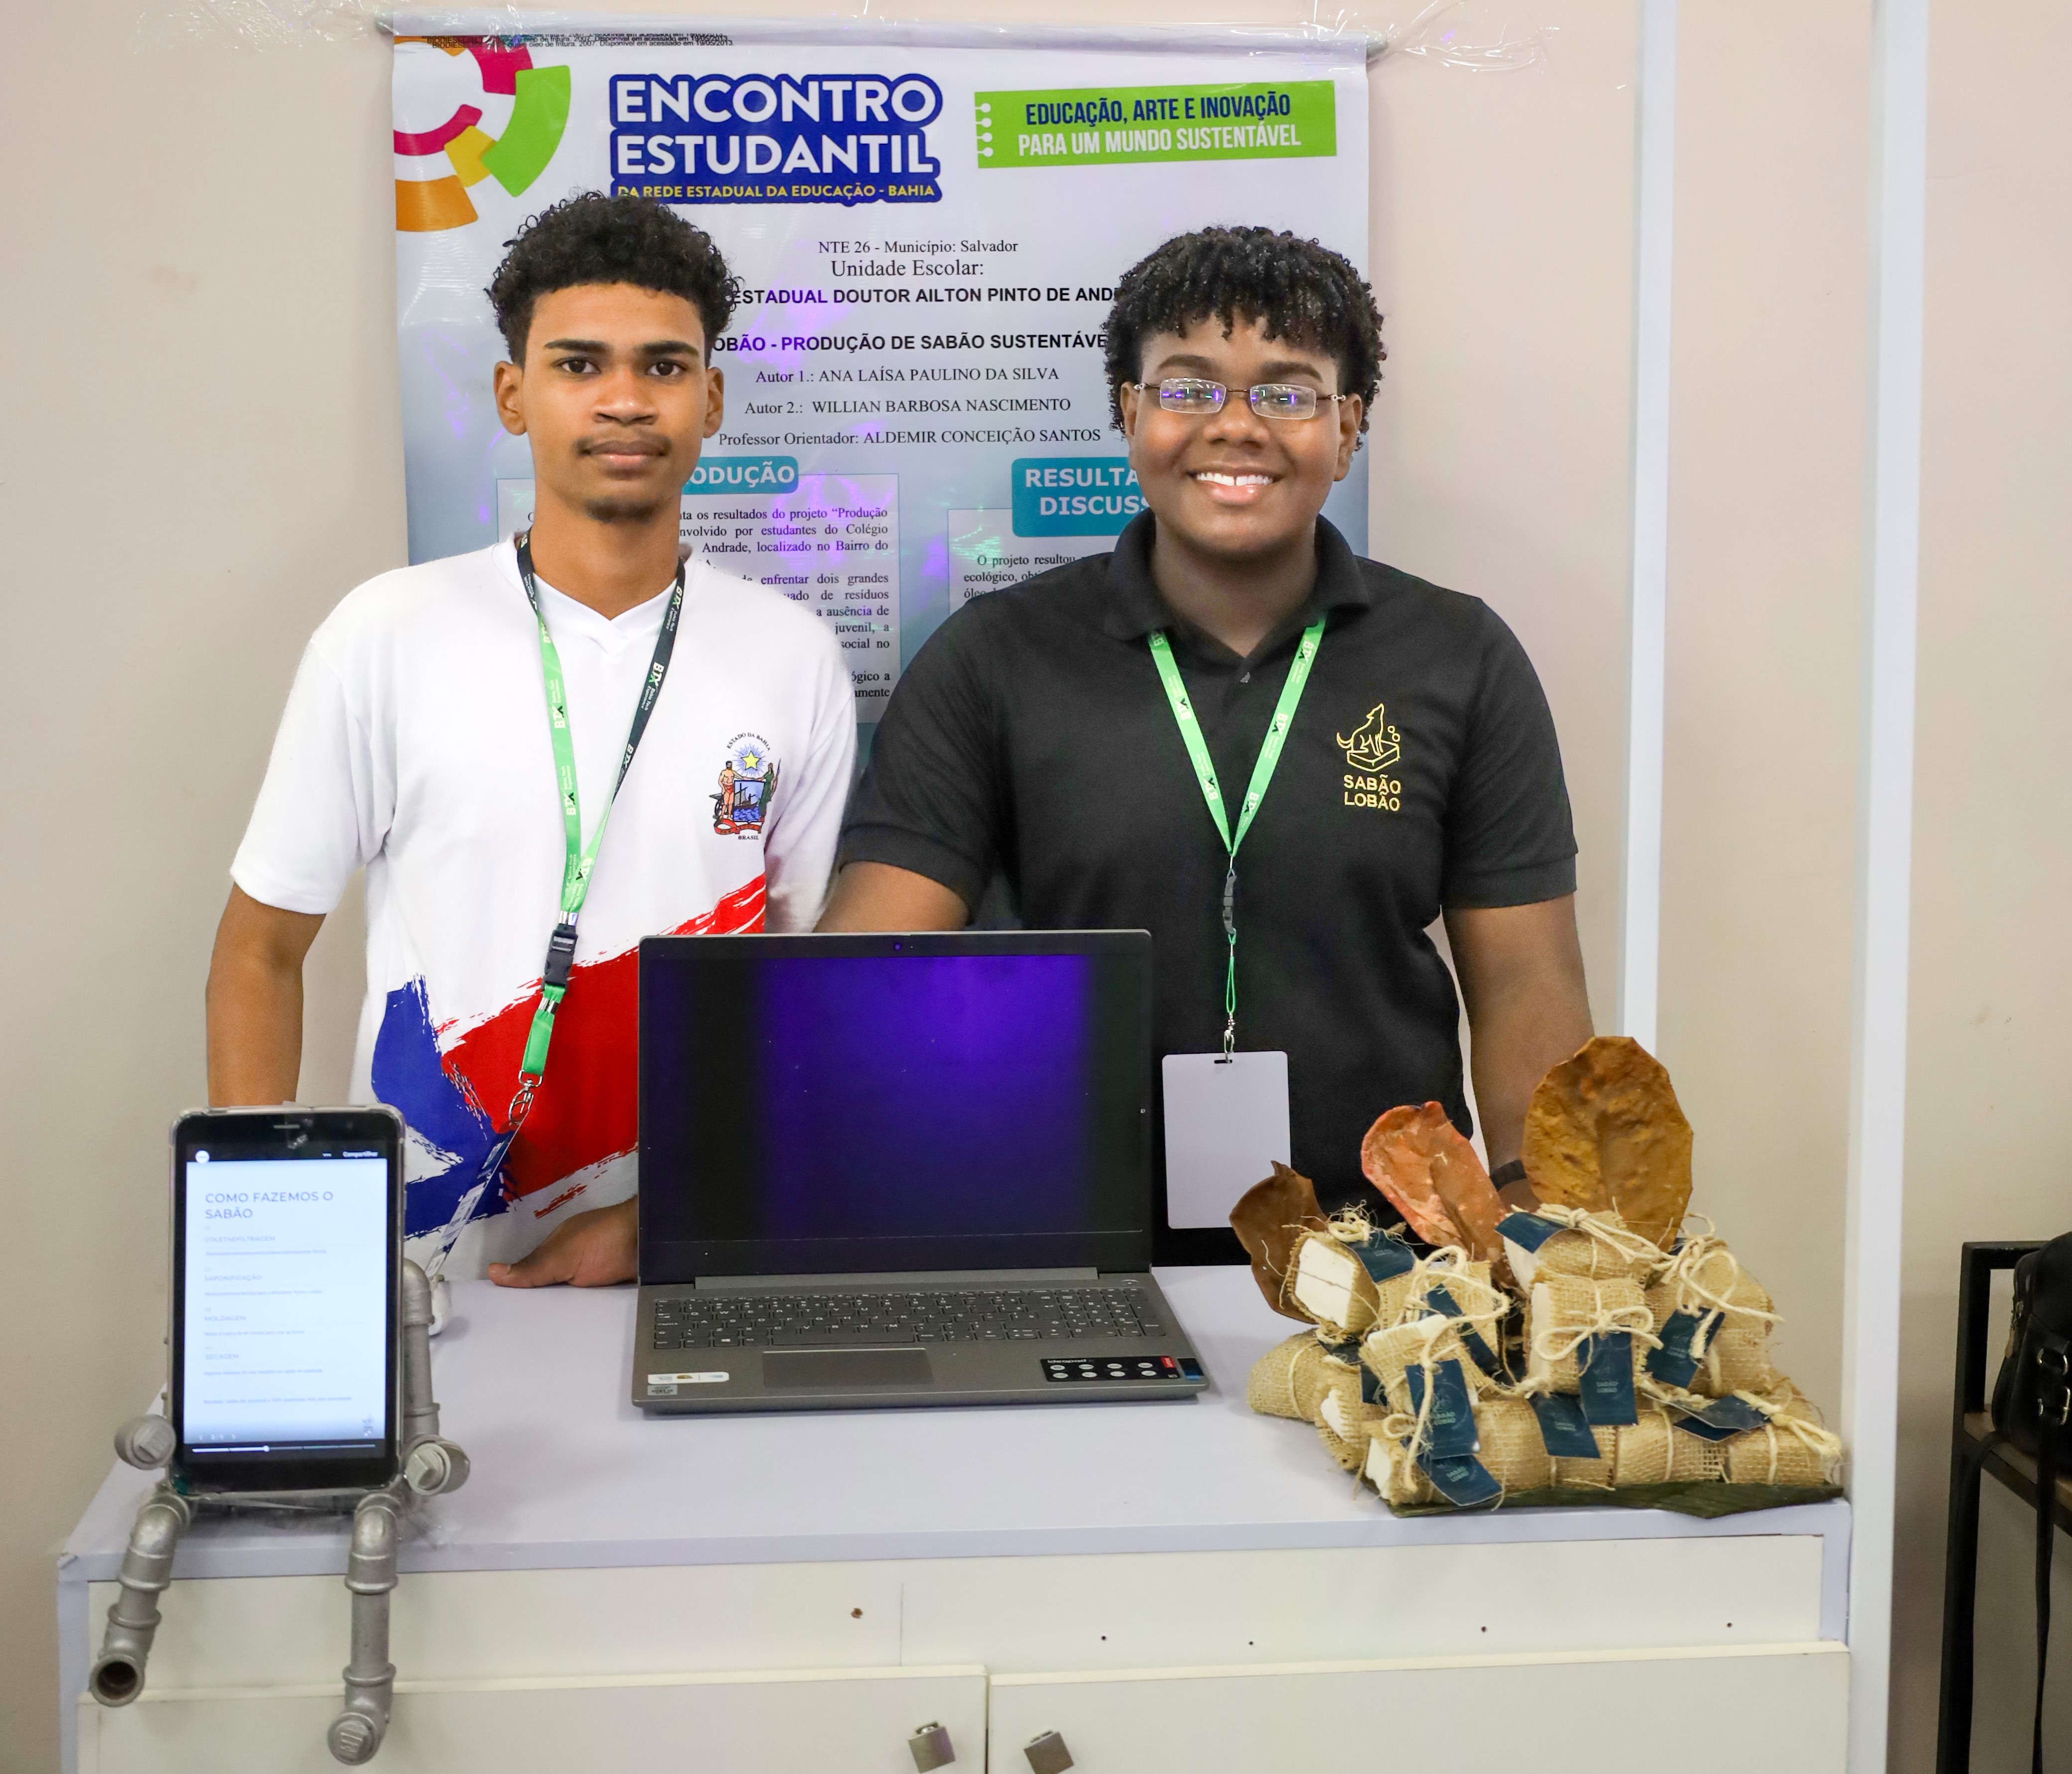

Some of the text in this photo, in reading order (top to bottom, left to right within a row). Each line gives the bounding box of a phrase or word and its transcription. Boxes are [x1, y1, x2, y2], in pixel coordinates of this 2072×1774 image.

[616, 80, 936, 123] ENCONTRO
[1026, 91, 1291, 127] EDUCAÇÃO, ARTE E INOVAÇÃO
[1019, 121, 1301, 156] PARA UM MUNDO SUSTENTÁVEL
[617, 134, 933, 174] ESTUDANTIL
[618, 186, 639, 197] DA
[643, 185, 682, 198] REDE
[686, 185, 763, 197] ESTADUAL
[766, 185, 788, 197] DA
[791, 182, 876, 200] EDUCAÇÃO
[888, 185, 934, 197] BAHIA
[818, 241, 850, 253] NTE
[854, 241, 871, 253] 26
[884, 240, 956, 255] Município:
[960, 240, 1019, 252] Salvador
[831, 259, 984, 276] Unidade Escolar:
[733, 287, 1120, 304] ESTADUAL DOUTOR AILTON PINTO DE AND
[713, 334, 766, 352] OBÃO
[781, 333, 886, 354] PRODUÇÃO
[891, 336, 915, 350] DE
[920, 332, 985, 349] SABÃO
[990, 331, 1108, 349] SUSTENTÁVE
[755, 371, 794, 383] Autor
[818, 370, 854, 382] ANA
[858, 366, 906, 382] LAÍSA
[910, 368, 981, 381] PAULINO
[985, 368, 1009, 380] DA
[1012, 368, 1060, 380] SILVA
[744, 401, 783, 414] Autor
[811, 400, 882, 413] WILLIAN
[885, 399, 962, 413] BARBOSA
[965, 398, 1071, 412] NASCIMENTO
[718, 427, 1101, 446] Professor Orientador: ALDEMIR CONCEIÇÃO SANTOS
[689, 460, 796, 489] ODUÇÃO
[1025, 467, 1139, 488] RESULTA
[697, 512, 709, 520] os
[713, 509, 768, 520] resultados
[772, 509, 785, 519] do
[789, 508, 828, 522] projeto
[680, 523, 889, 539] nvolvido por estudantes do Colégio
[702, 540, 889, 554] Andrade, localizado no Bairro do
[977, 554, 987, 566] O
[992, 554, 1030, 568] projeto
[1034, 554, 1076, 564] resultou
[761, 574, 809, 585] enfrentar
[817, 573, 840, 584] dois
[847, 573, 889, 586] grandes
[963, 571, 1018, 584] ecológico,
[672, 585, 683, 610] BTX
[820, 589, 890, 600] de resíduos
[826, 606, 872, 617] ausência
[876, 605, 890, 616] de
[835, 622, 876, 635] juvenil,
[1298, 640, 1314, 663] BTX
[648, 661, 665, 687] BTX
[884, 673, 891, 681] a
[551, 704, 566, 728] BTX
[1174, 698, 1192, 721] BTX
[1272, 712, 1289, 736] BTX
[726, 732, 747, 749] ESTADO
[756, 734, 771, 752] BAHIA
[622, 743, 635, 768] BTX
[1203, 777, 1219, 801] BTX
[1343, 773, 1402, 794] SABÃO
[563, 791, 577, 816] BTX
[1244, 791, 1260, 815] BTX
[1344, 790, 1401, 812] LOBÃO
[575, 858, 593, 881] BTX
[205, 1191, 334, 1204] COMO FAZEMOS O
[205, 1207, 253, 1220] SABÃO
